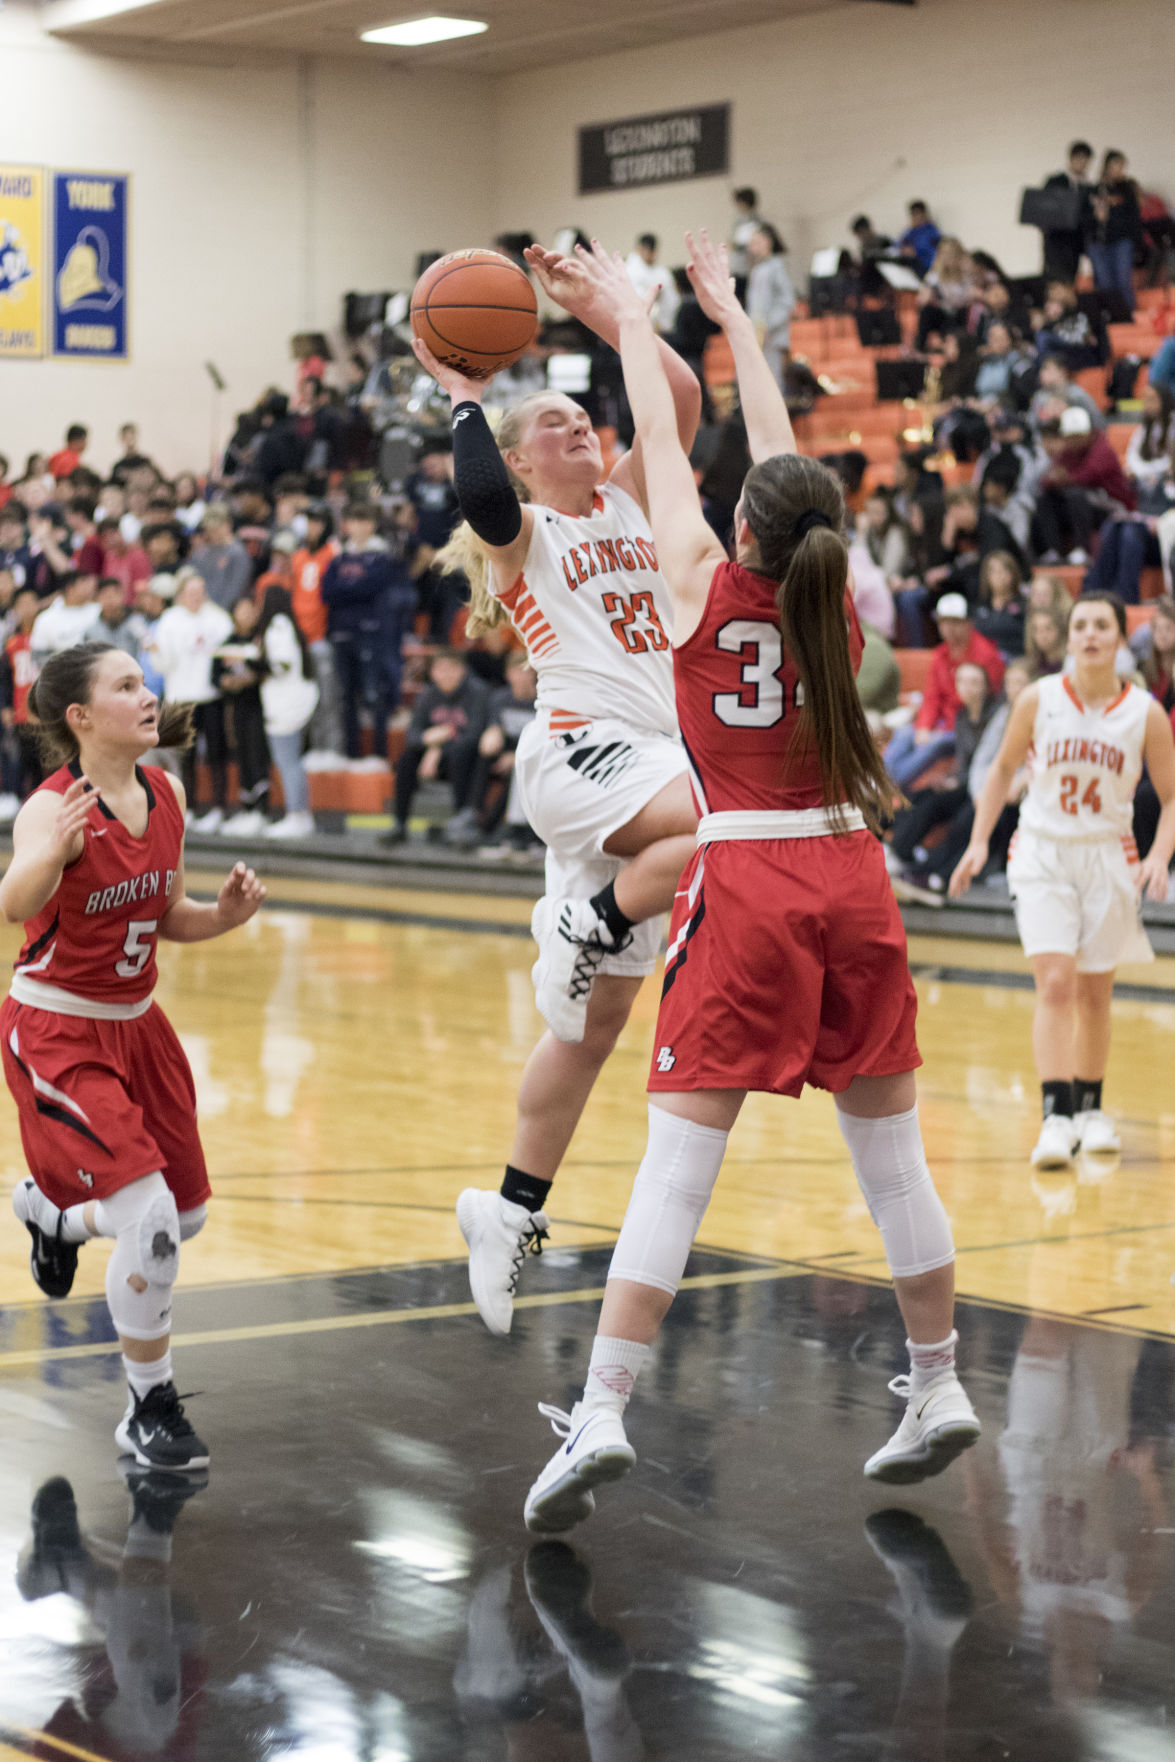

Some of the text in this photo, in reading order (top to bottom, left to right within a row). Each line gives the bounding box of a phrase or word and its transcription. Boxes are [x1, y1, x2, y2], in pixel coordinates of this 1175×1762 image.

[562, 536, 659, 592] LEXINGTO
[601, 591, 670, 654] 23
[712, 618, 804, 730] 3
[1048, 737, 1125, 776] LEXINGTON
[1060, 775, 1102, 816] 24
[84, 868, 177, 915] BROKEN B
[114, 919, 158, 978] 5
